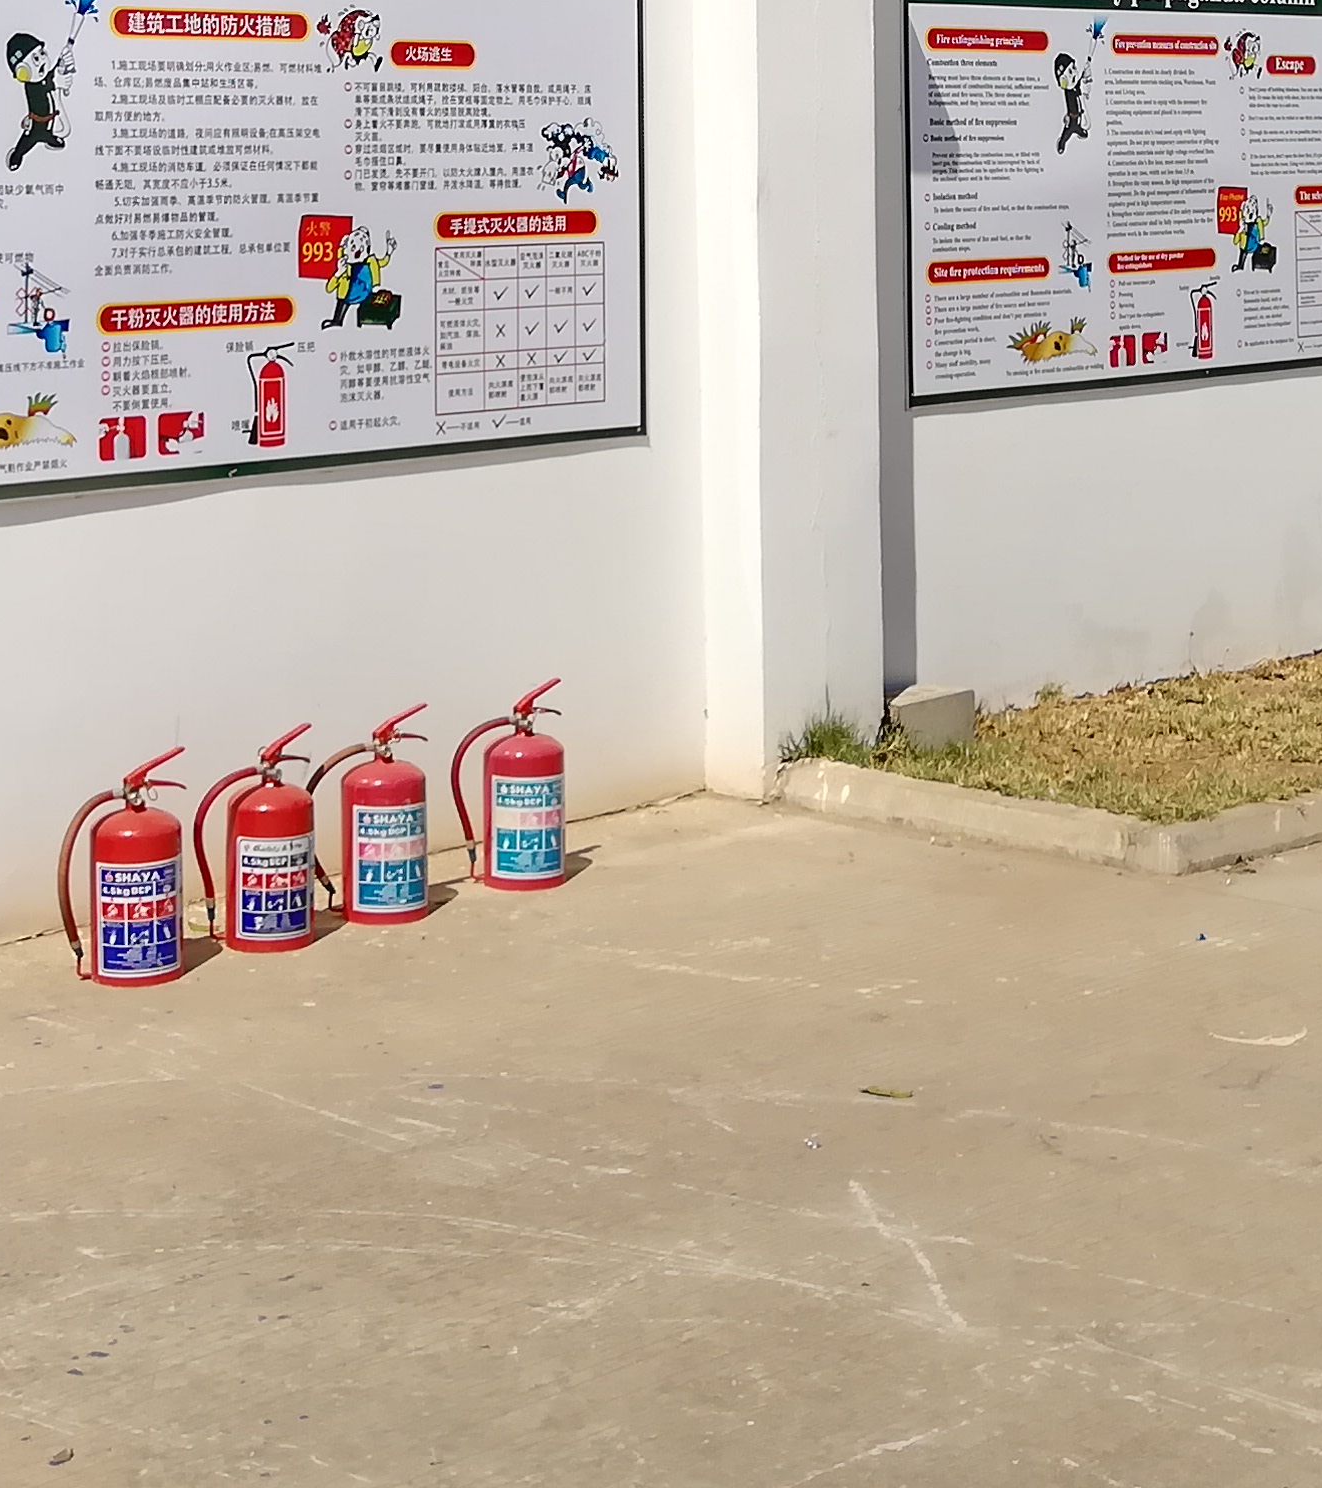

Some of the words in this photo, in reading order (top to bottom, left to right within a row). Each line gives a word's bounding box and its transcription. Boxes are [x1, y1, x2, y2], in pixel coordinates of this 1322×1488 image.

[127, 12, 291, 36] 建筑工地的防火措施
[936, 34, 950, 44] Fire
[951, 35, 994, 46] extinguishing
[995, 36, 1023, 47] principle
[405, 46, 452, 63] 火场逃生
[1276, 57, 1304, 73] Escape
[946, 118, 966, 126] method
[1299, 191, 1311, 200] The
[1219, 207, 1237, 222] 993
[306, 220, 331, 236] 火警
[450, 216, 567, 236] 手提式灭火器的选用
[932, 223, 954, 231] Cooling
[302, 241, 334, 263] 993
[934, 267, 948, 278] Site
[949, 266, 962, 277] fire
[963, 265, 999, 279] protection
[1000, 263, 1045, 277] requirements
[111, 301, 276, 330] 干粉灭火器的使用方法
[510, 785, 550, 794] SHAYA
[373, 813, 413, 824] SHAYA
[114, 871, 160, 882] SHAYA
